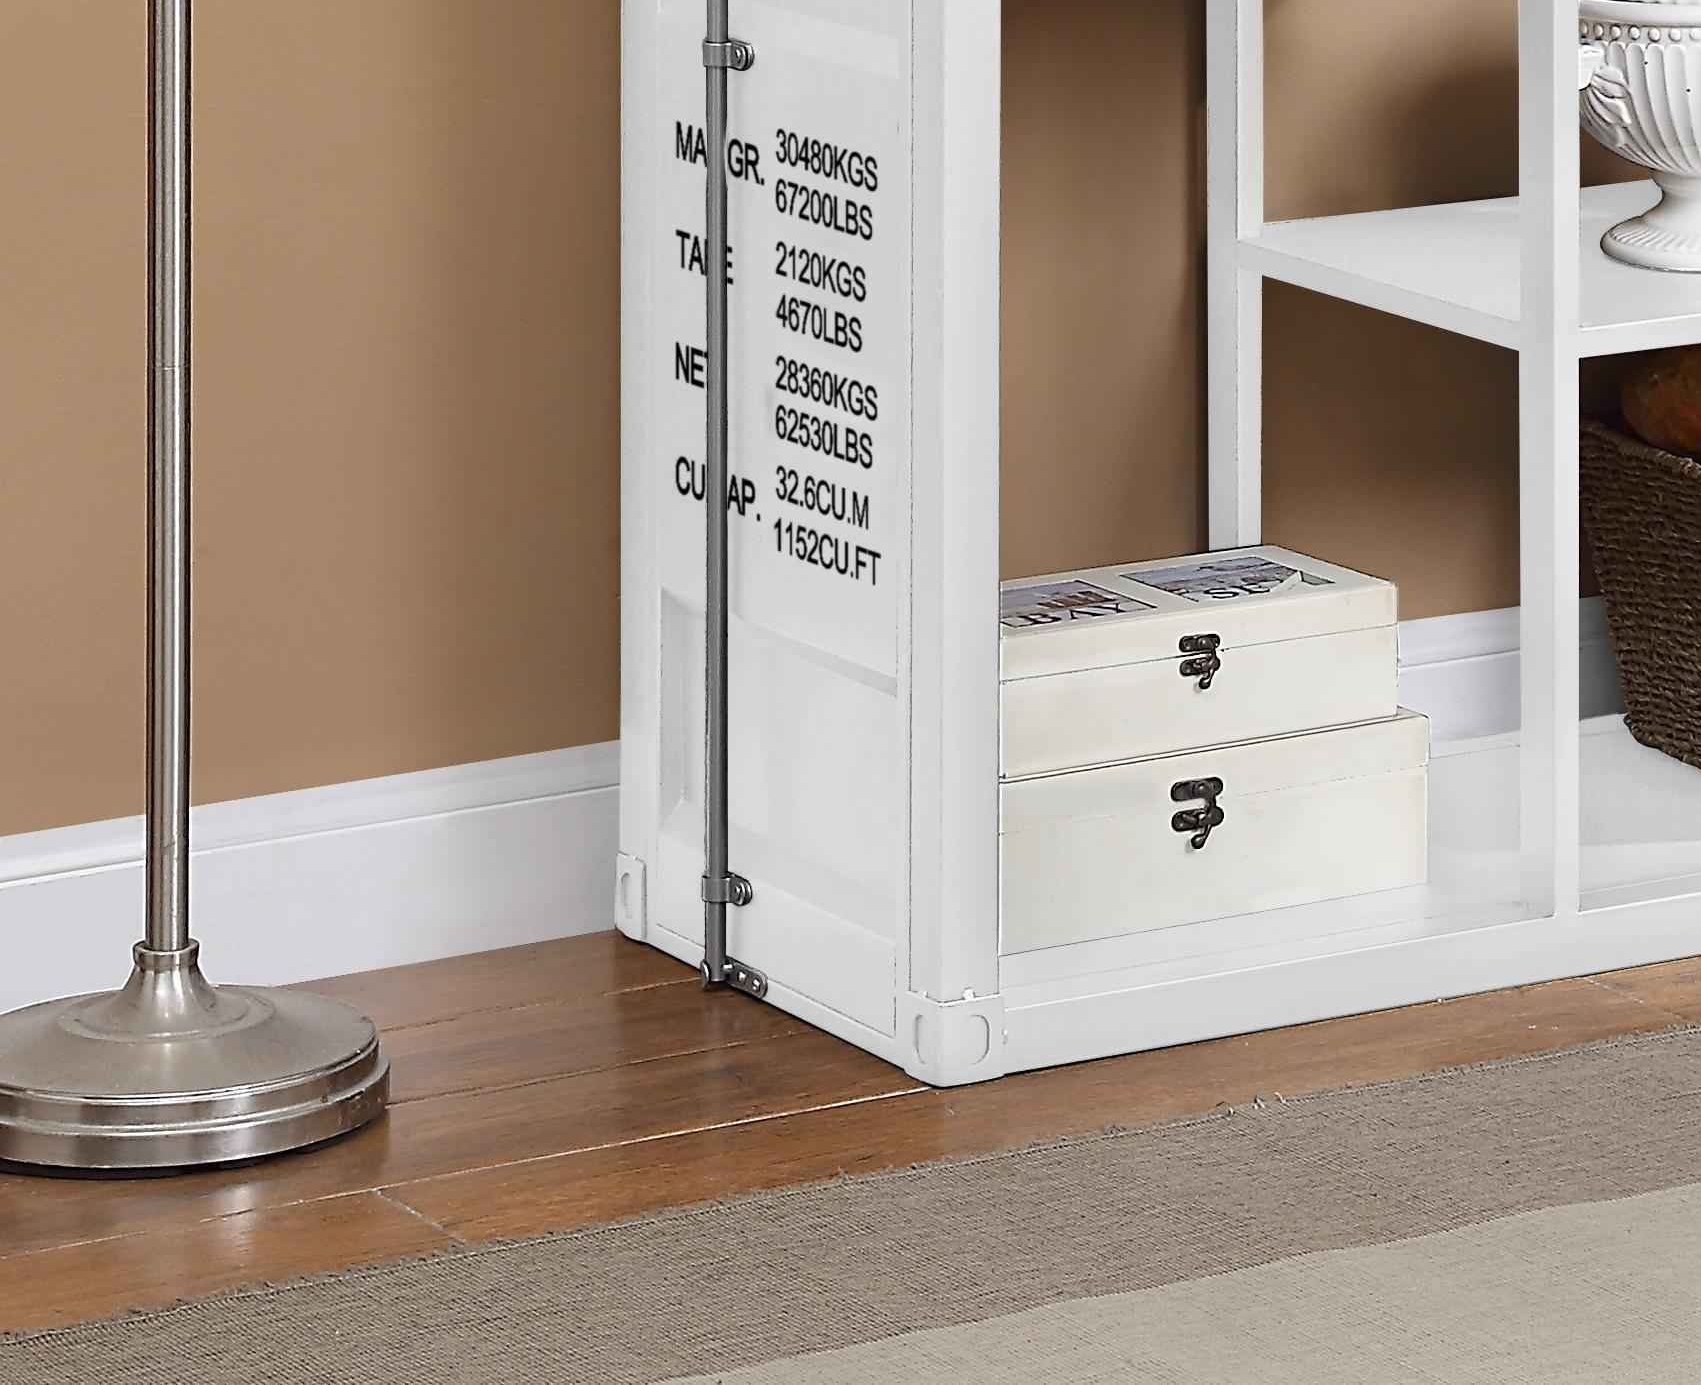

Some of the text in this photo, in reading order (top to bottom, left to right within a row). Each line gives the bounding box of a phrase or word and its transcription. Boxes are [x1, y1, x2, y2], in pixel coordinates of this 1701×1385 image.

[675, 120, 765, 186] MA GR.
[775, 128, 878, 192] 30480KGS
[775, 178, 873, 241] 67200LBS
[775, 241, 867, 303] 2120KGS
[775, 294, 863, 353] 4670LBS
[675, 341, 708, 389] NE
[775, 355, 878, 422] 28360KGS
[775, 404, 873, 470] 62530LBS
[727, 474, 761, 522] AP.
[775, 465, 869, 531] 32.6CU.M
[773, 517, 882, 586] 1152CU.FT
